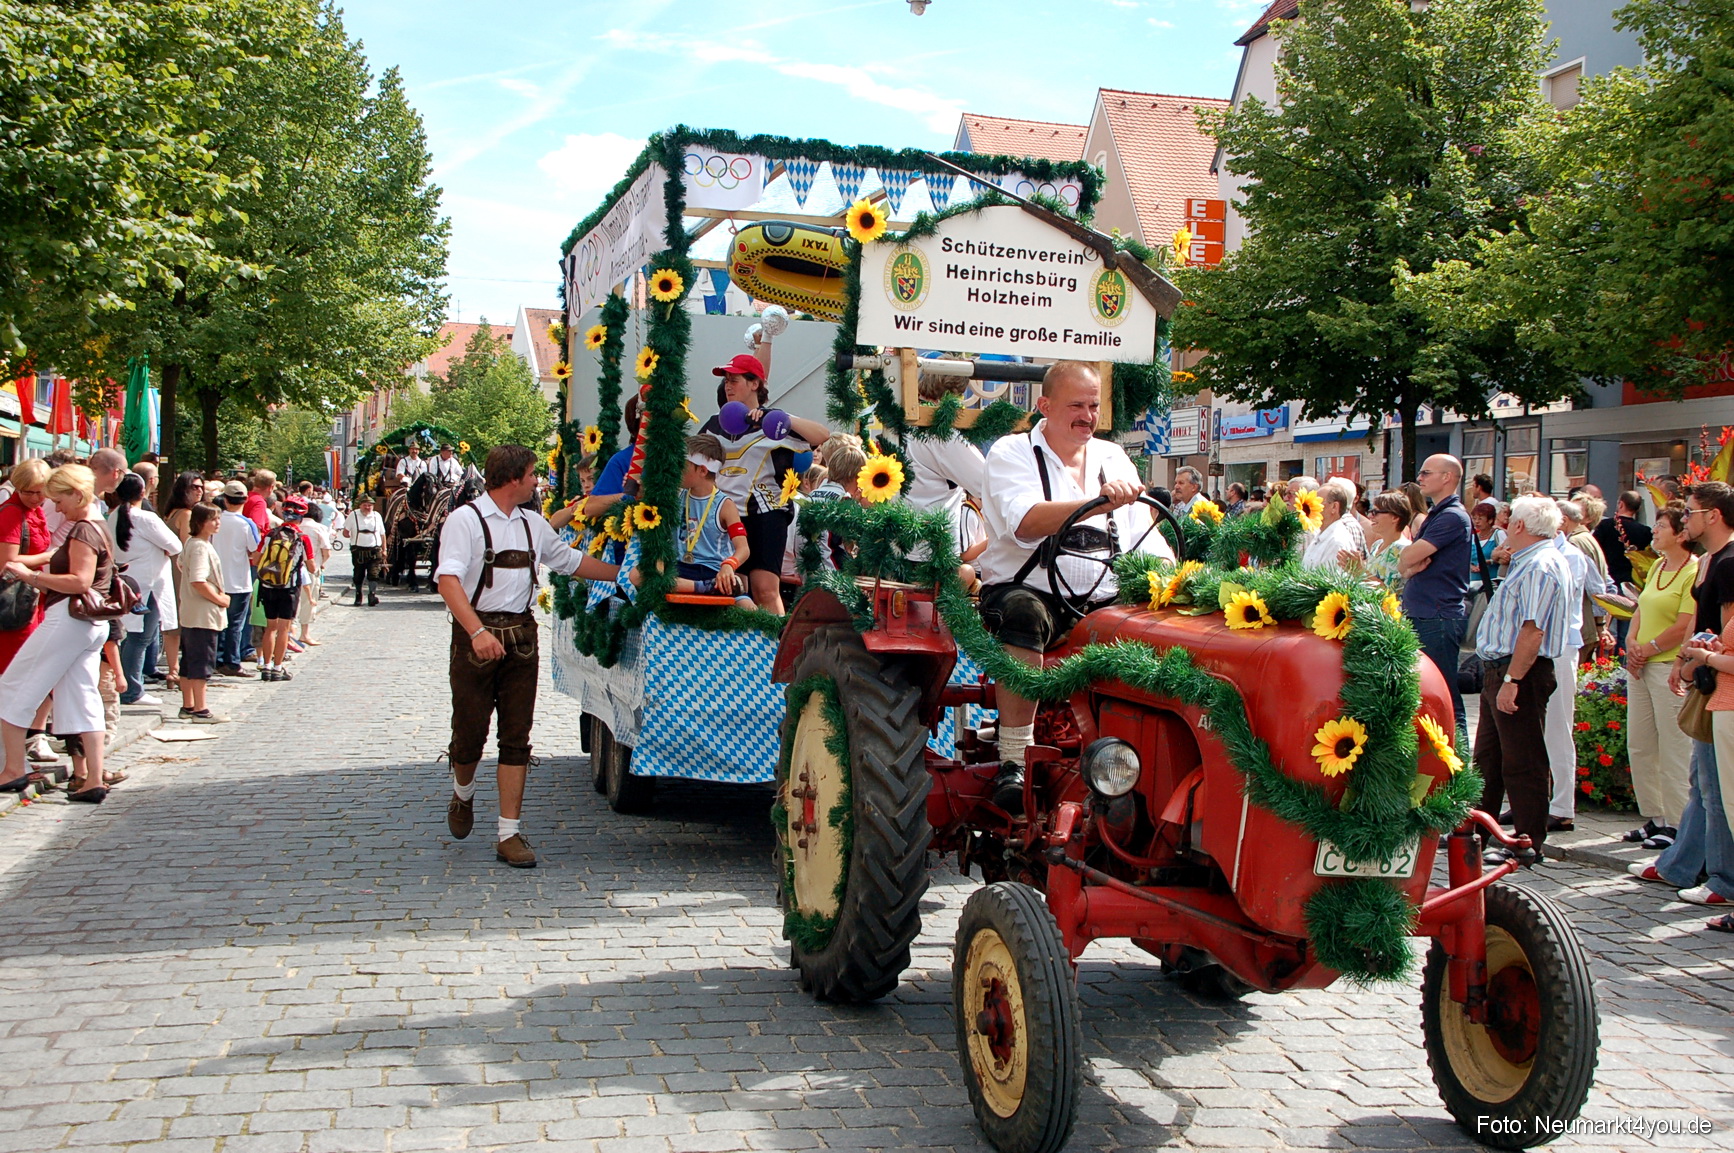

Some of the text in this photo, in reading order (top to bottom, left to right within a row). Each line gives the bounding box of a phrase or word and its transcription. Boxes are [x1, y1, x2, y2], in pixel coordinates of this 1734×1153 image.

[802, 238, 829, 252] TAXI
[941, 237, 1084, 265] Schützenverein
[946, 264, 1077, 292] Heinrichsbürg
[967, 287, 1052, 307] Holzheim
[894, 315, 1122, 347] Wir sind eine große Familie
